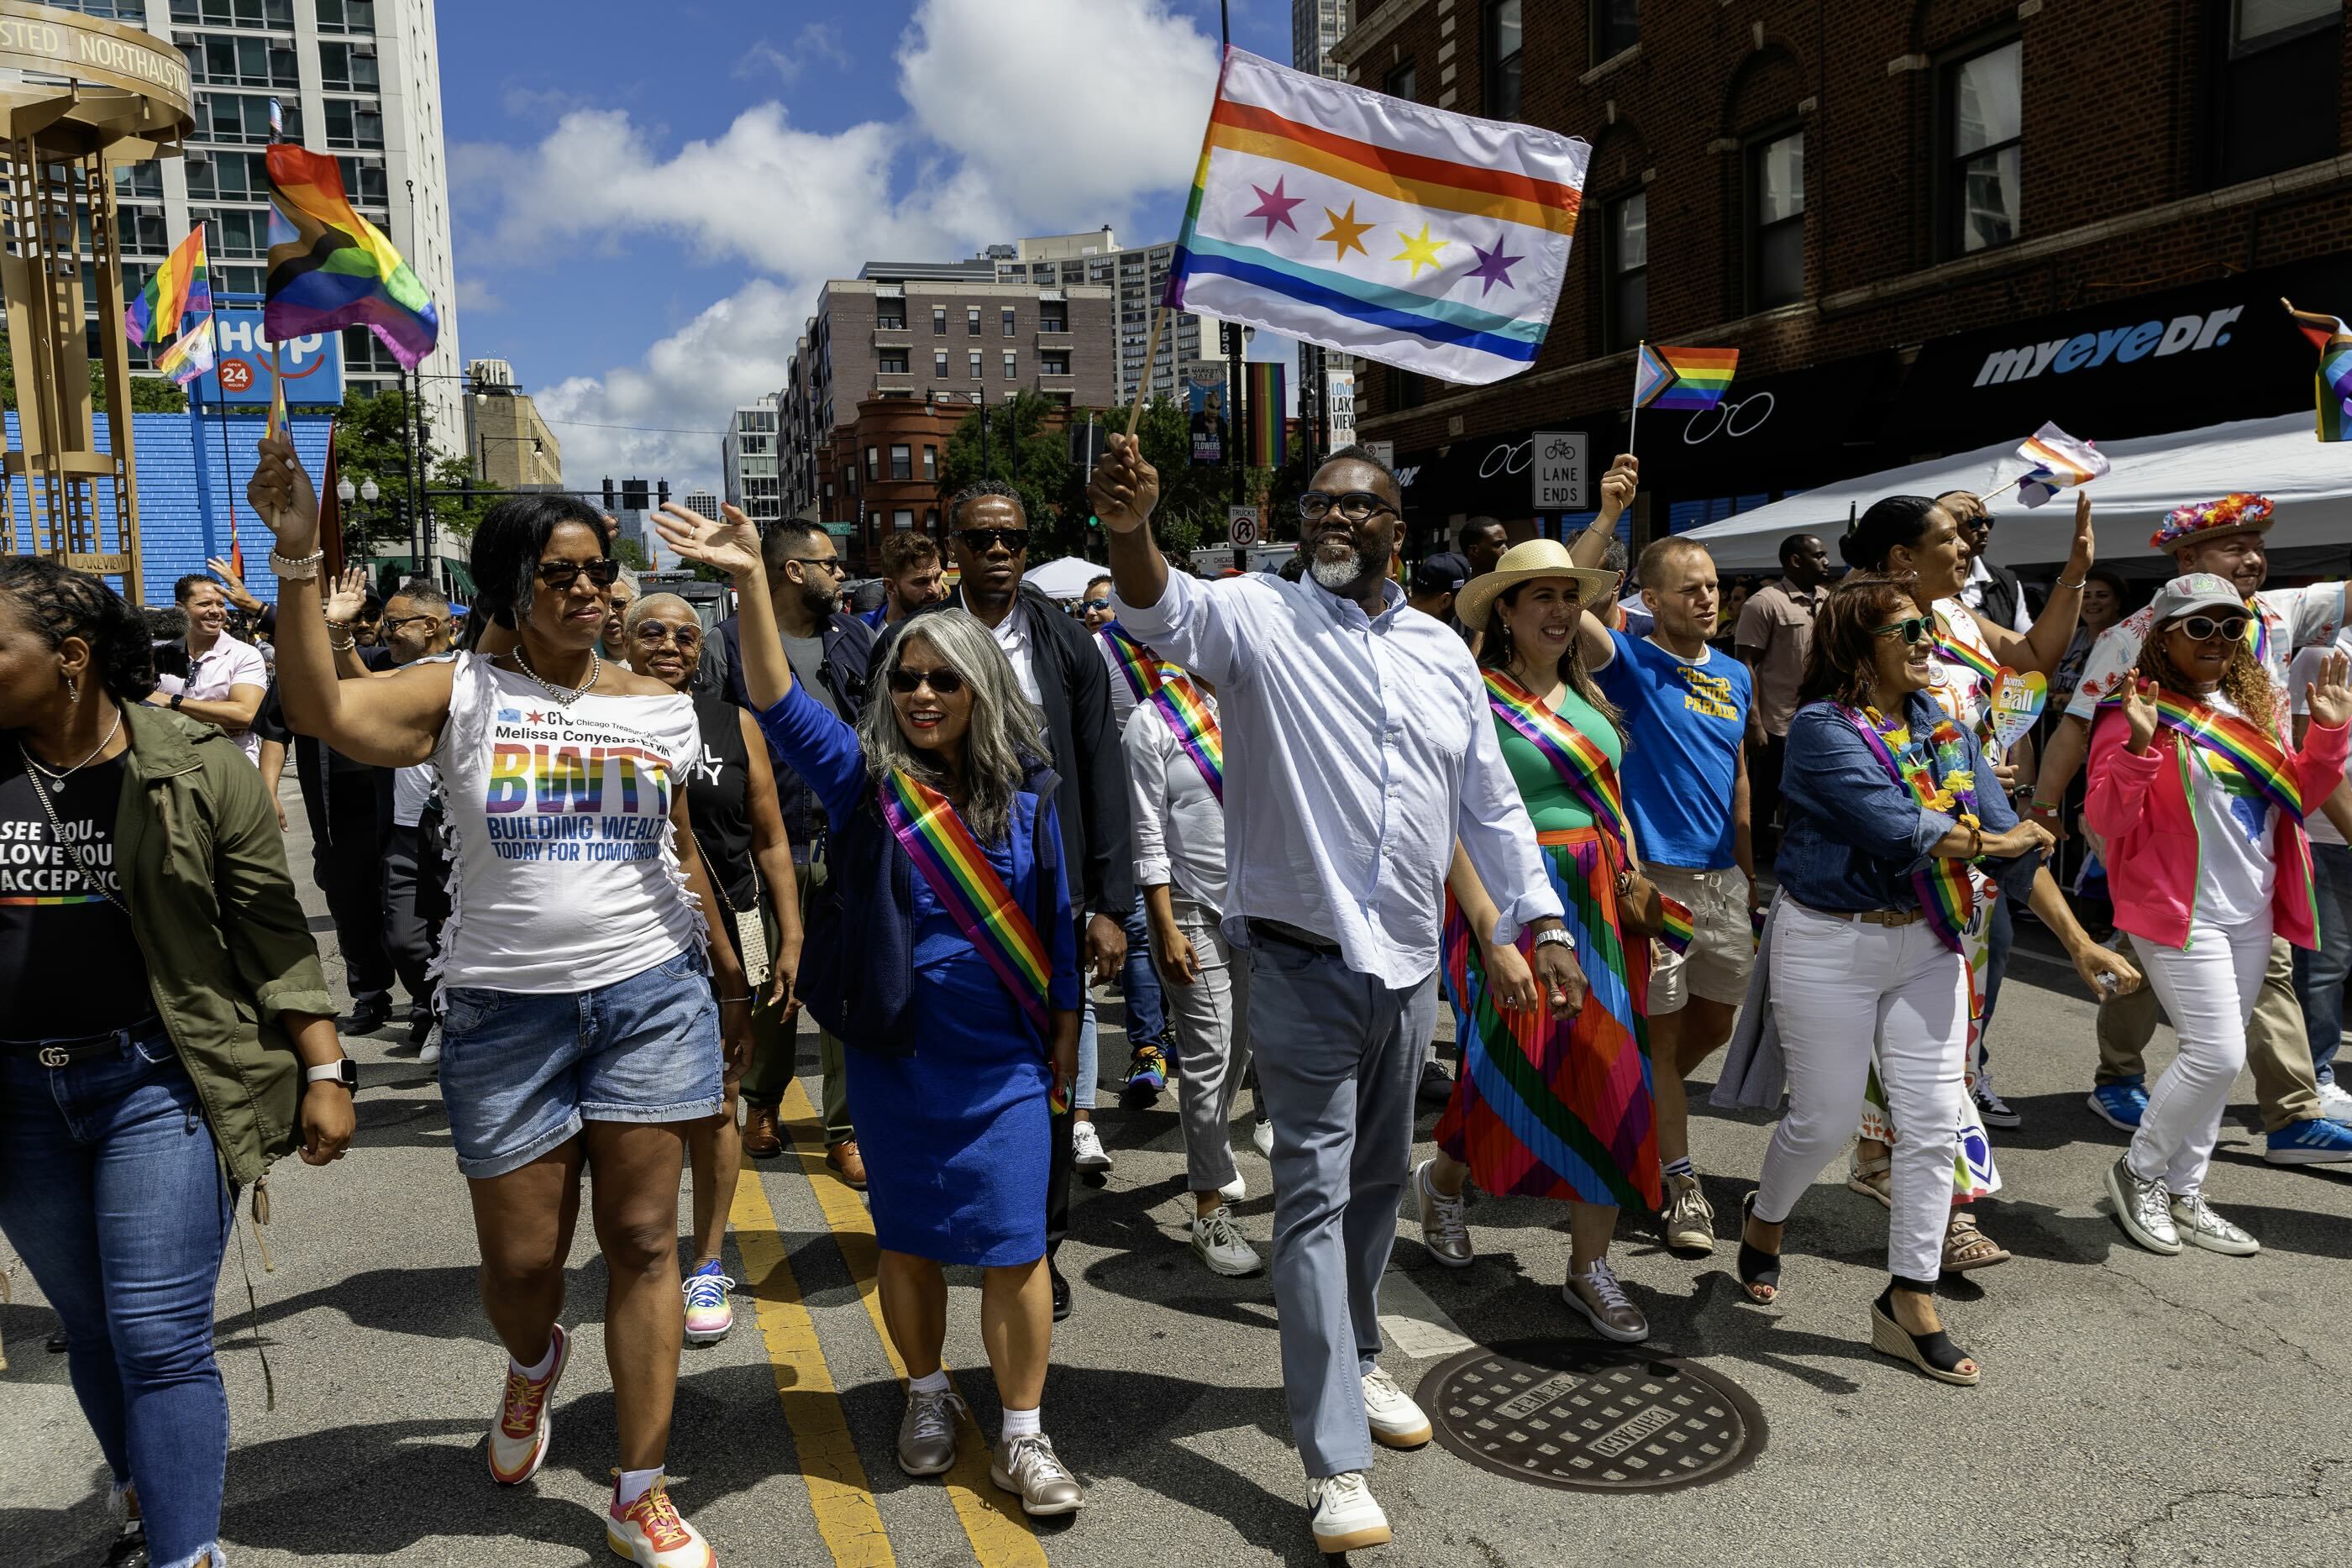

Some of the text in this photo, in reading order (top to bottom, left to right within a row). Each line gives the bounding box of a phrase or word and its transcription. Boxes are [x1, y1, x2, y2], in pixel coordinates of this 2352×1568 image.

[79, 34, 189, 97] NORTHALSTED
[223, 368, 248, 383] 24
[1332, 397, 1355, 412] LAK
[1332, 431, 1357, 442] EAS
[1194, 442, 1221, 450] FLOWERS
[1543, 467, 1578, 481] LANE
[1543, 488, 1578, 502] ENDS
[1232, 509, 1256, 517] TRUCKS
[76, 557, 125, 570] LAKEVIEW
[2003, 674, 2026, 687] home
[2010, 688, 2034, 712] all
[1684, 695, 1738, 721] PARADE
[576, 719, 610, 728] Chicago
[496, 726, 558, 739] Melissa
[0, 819, 93, 842] SEE YOU
[486, 815, 593, 840] BUILDING
[0, 843, 65, 865] LOVE
[491, 842, 543, 860] TODAY
[548, 842, 580, 862] FOR
[1506, 1379, 1573, 1413] SEWER
[1594, 1409, 1672, 1455] CHICAGO
